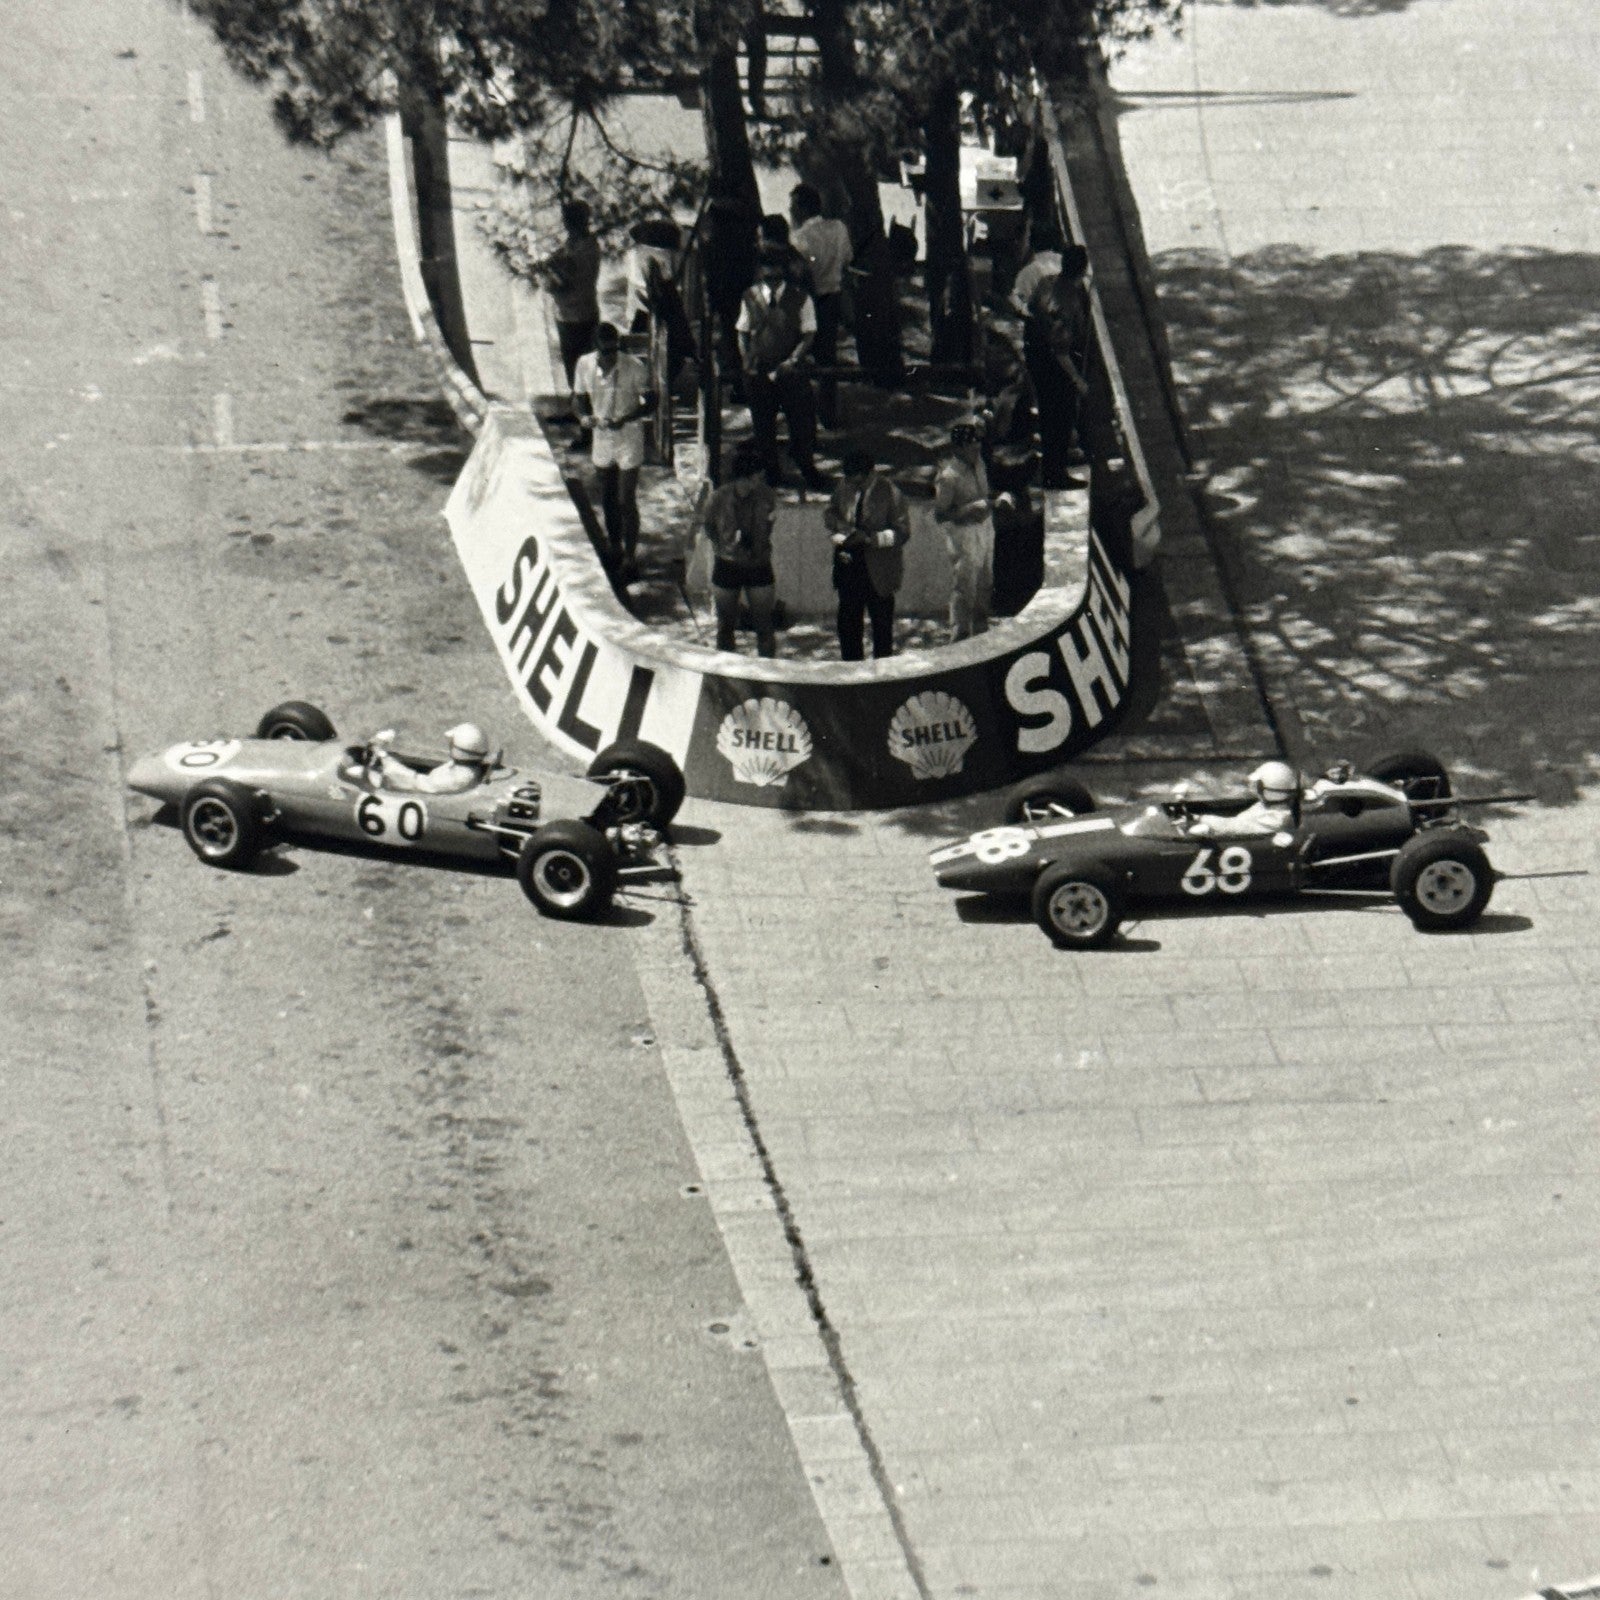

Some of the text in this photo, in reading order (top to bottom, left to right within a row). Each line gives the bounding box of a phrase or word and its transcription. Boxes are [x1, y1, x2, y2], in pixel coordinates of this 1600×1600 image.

[731, 729, 799, 754] SHELL
[902, 720, 967, 748] SHELL
[358, 795, 424, 841] 60
[1181, 846, 1252, 895] 68
